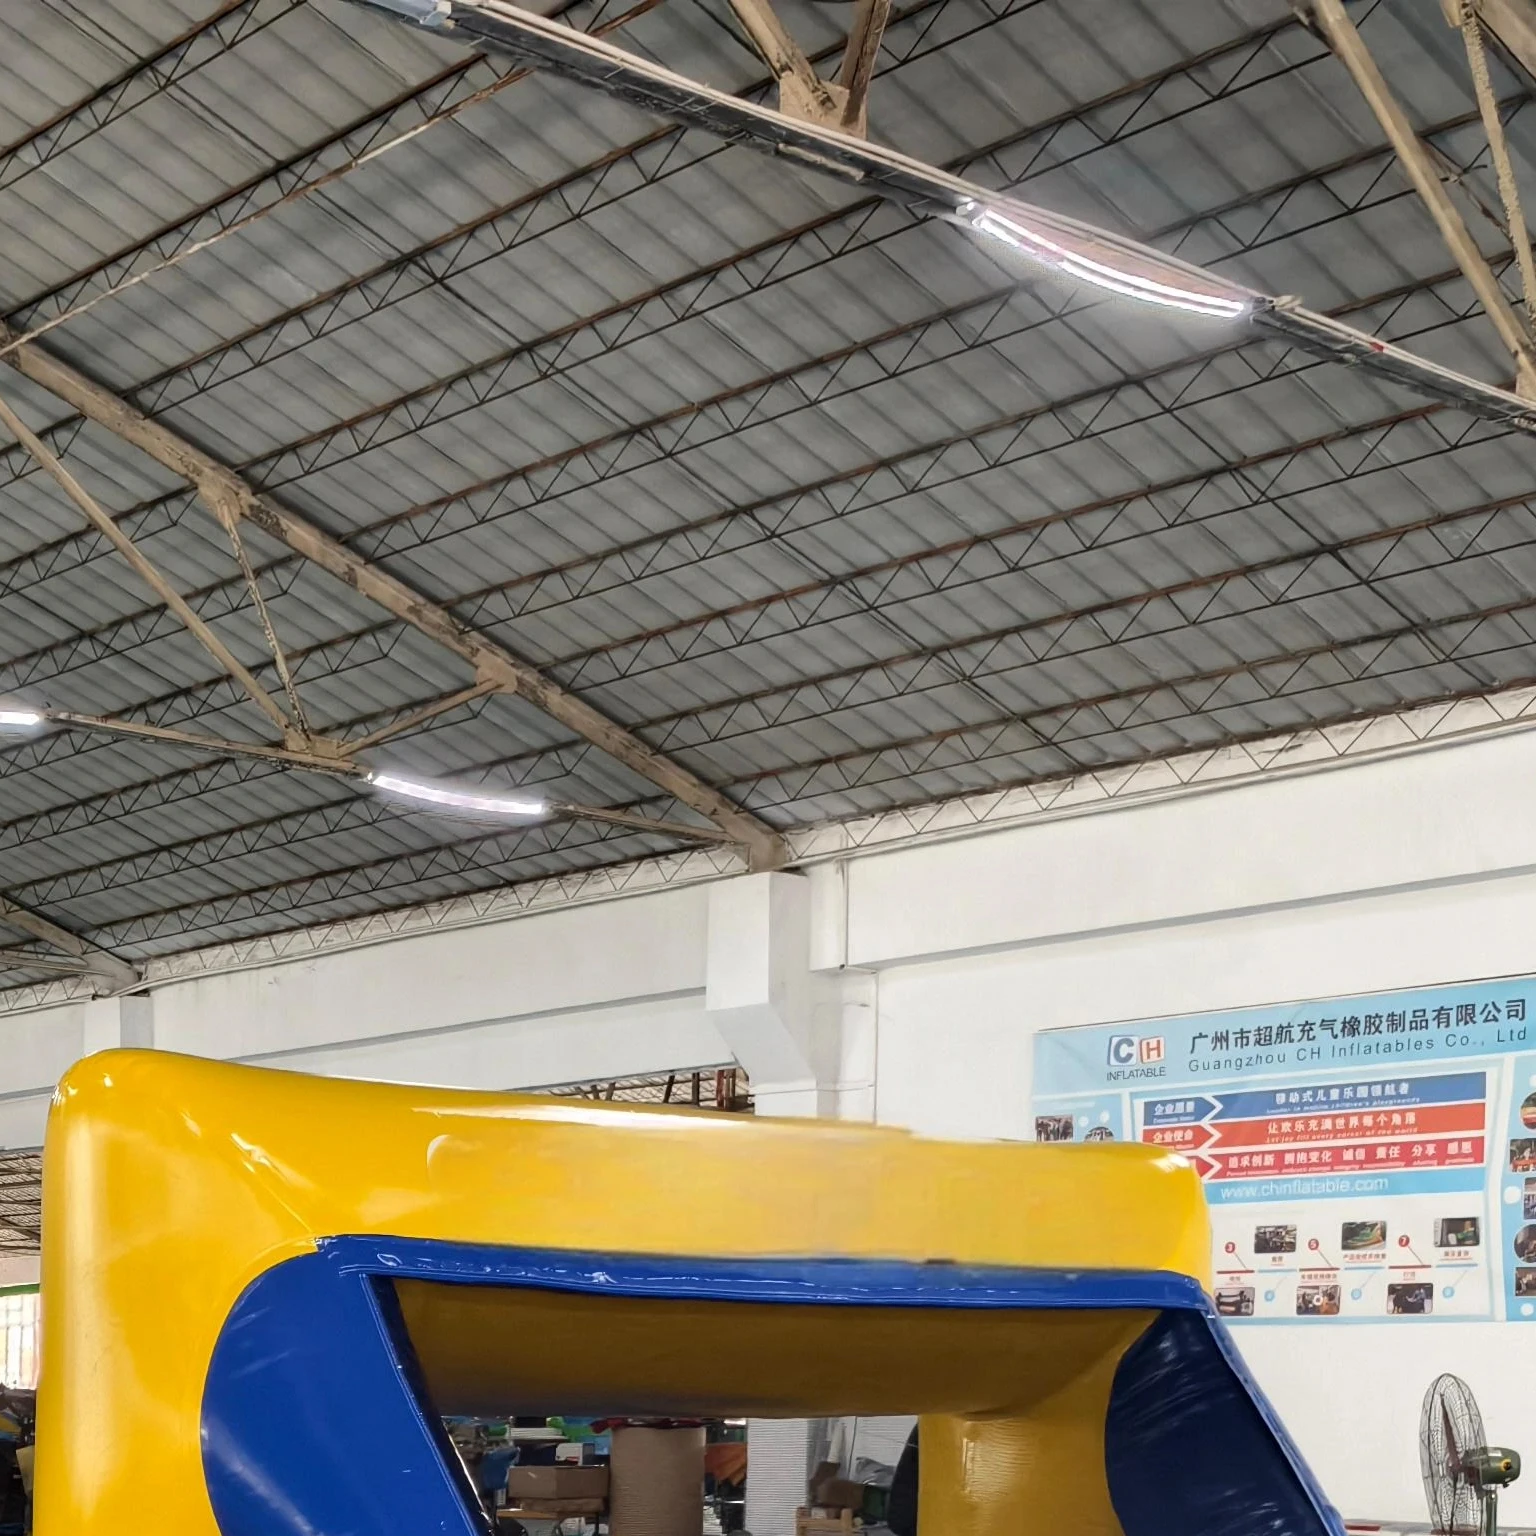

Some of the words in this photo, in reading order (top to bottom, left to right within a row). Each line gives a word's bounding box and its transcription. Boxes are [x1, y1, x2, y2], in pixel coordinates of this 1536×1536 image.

[1190, 998, 1526, 1055] 广州市超航充气橡胶制品有限公司
[1188, 1052, 1286, 1072] Guangzhou
[1296, 1046, 1321, 1061] CH
[1331, 1036, 1434, 1058] Inflatables
[1497, 1026, 1527, 1043] Ltd
[1106, 1066, 1167, 1081] INFLATABLE
[1220, 1176, 1389, 1200] www.chinflatable.com
